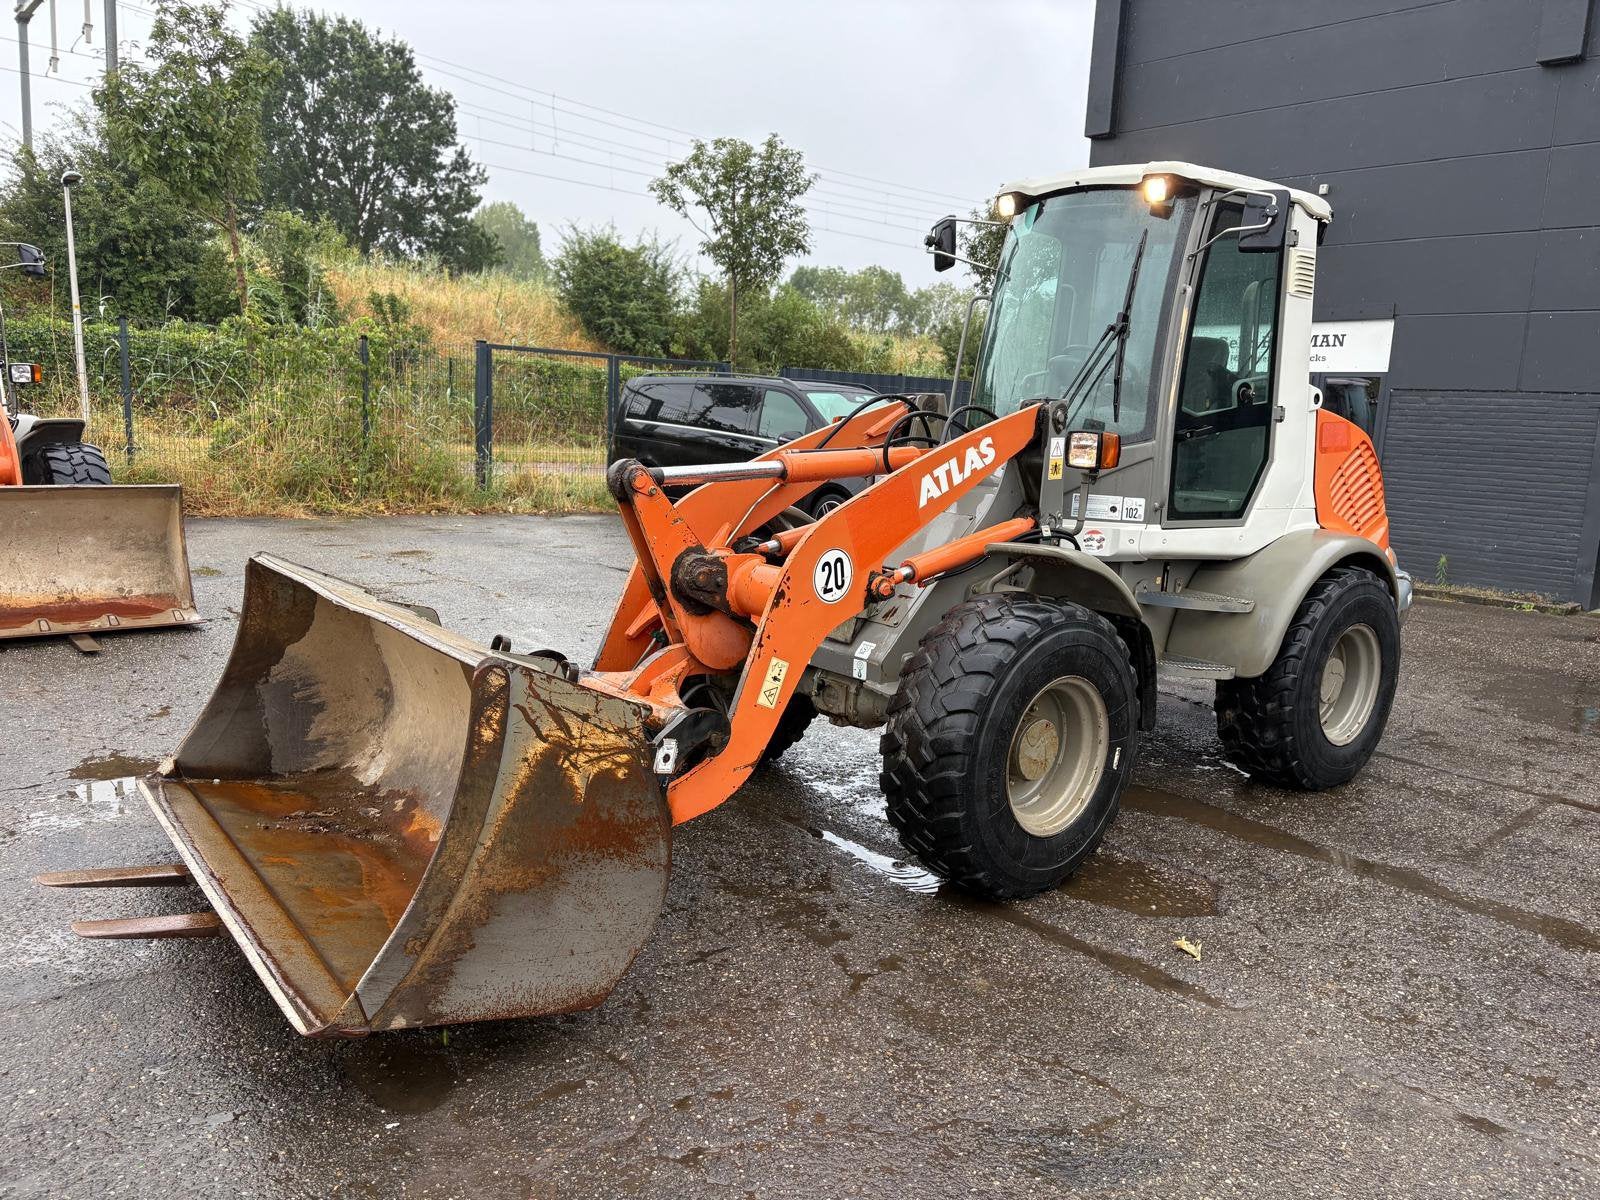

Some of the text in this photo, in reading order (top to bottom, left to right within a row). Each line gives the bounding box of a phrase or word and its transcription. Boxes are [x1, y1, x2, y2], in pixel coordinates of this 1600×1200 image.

[919, 436, 996, 509] ATLAS
[1125, 507, 1139, 519] 102
[821, 557, 845, 594] 20
